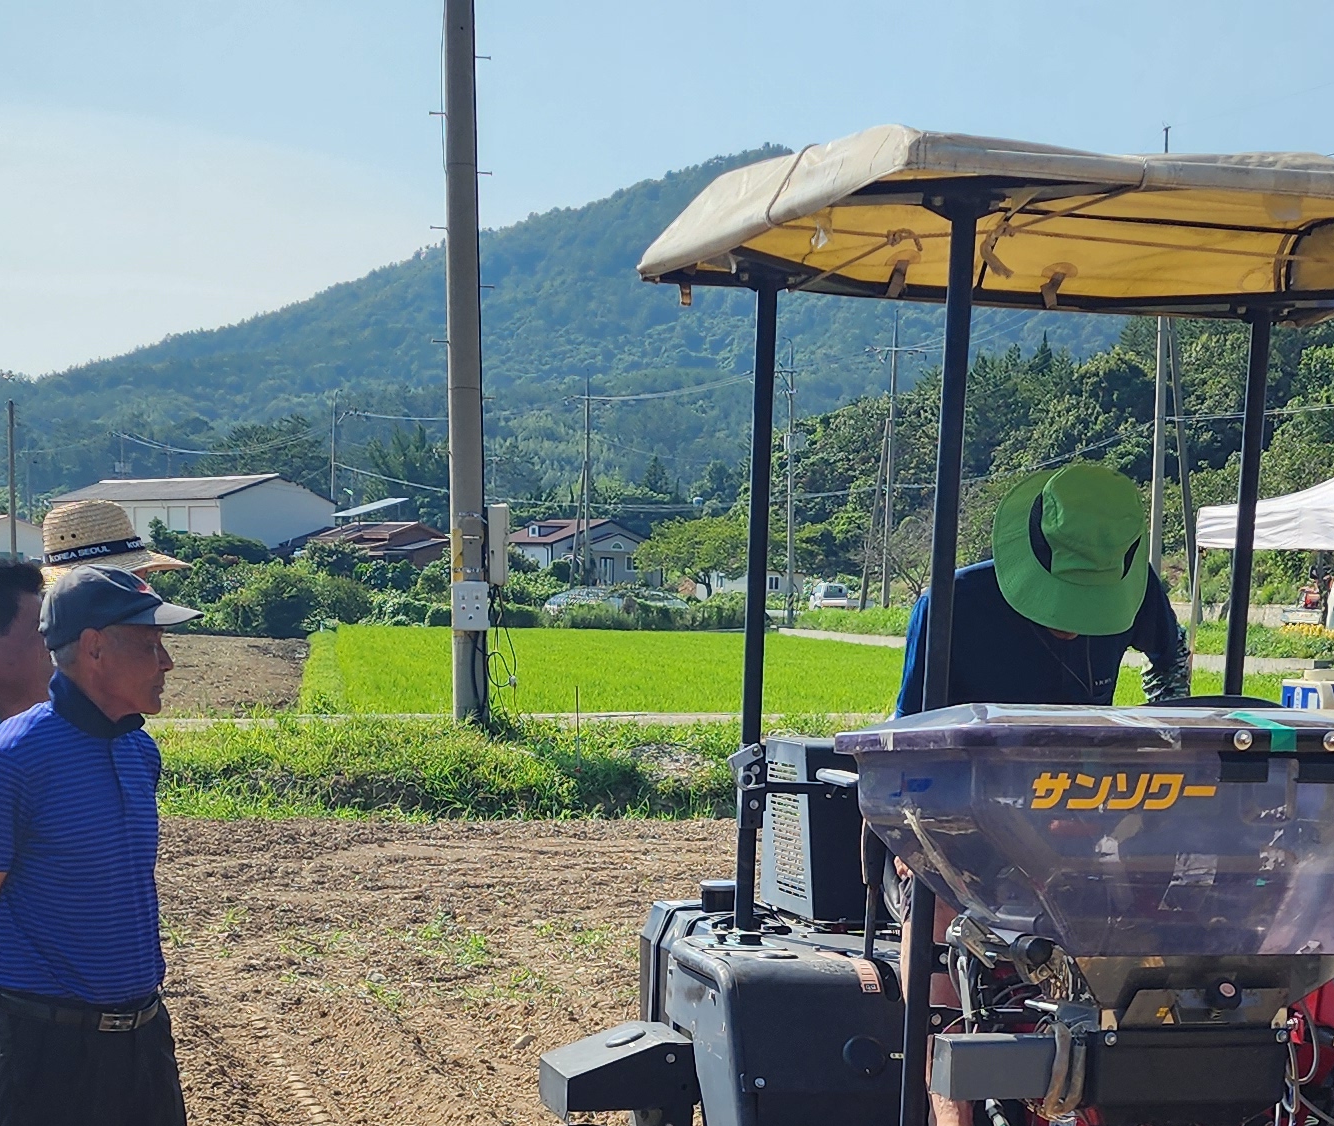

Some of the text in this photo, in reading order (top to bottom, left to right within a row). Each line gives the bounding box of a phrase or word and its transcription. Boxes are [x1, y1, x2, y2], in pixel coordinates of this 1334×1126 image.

[78, 545, 111, 557] SEOUL
[1030, 772, 1217, 810] サンソワー
